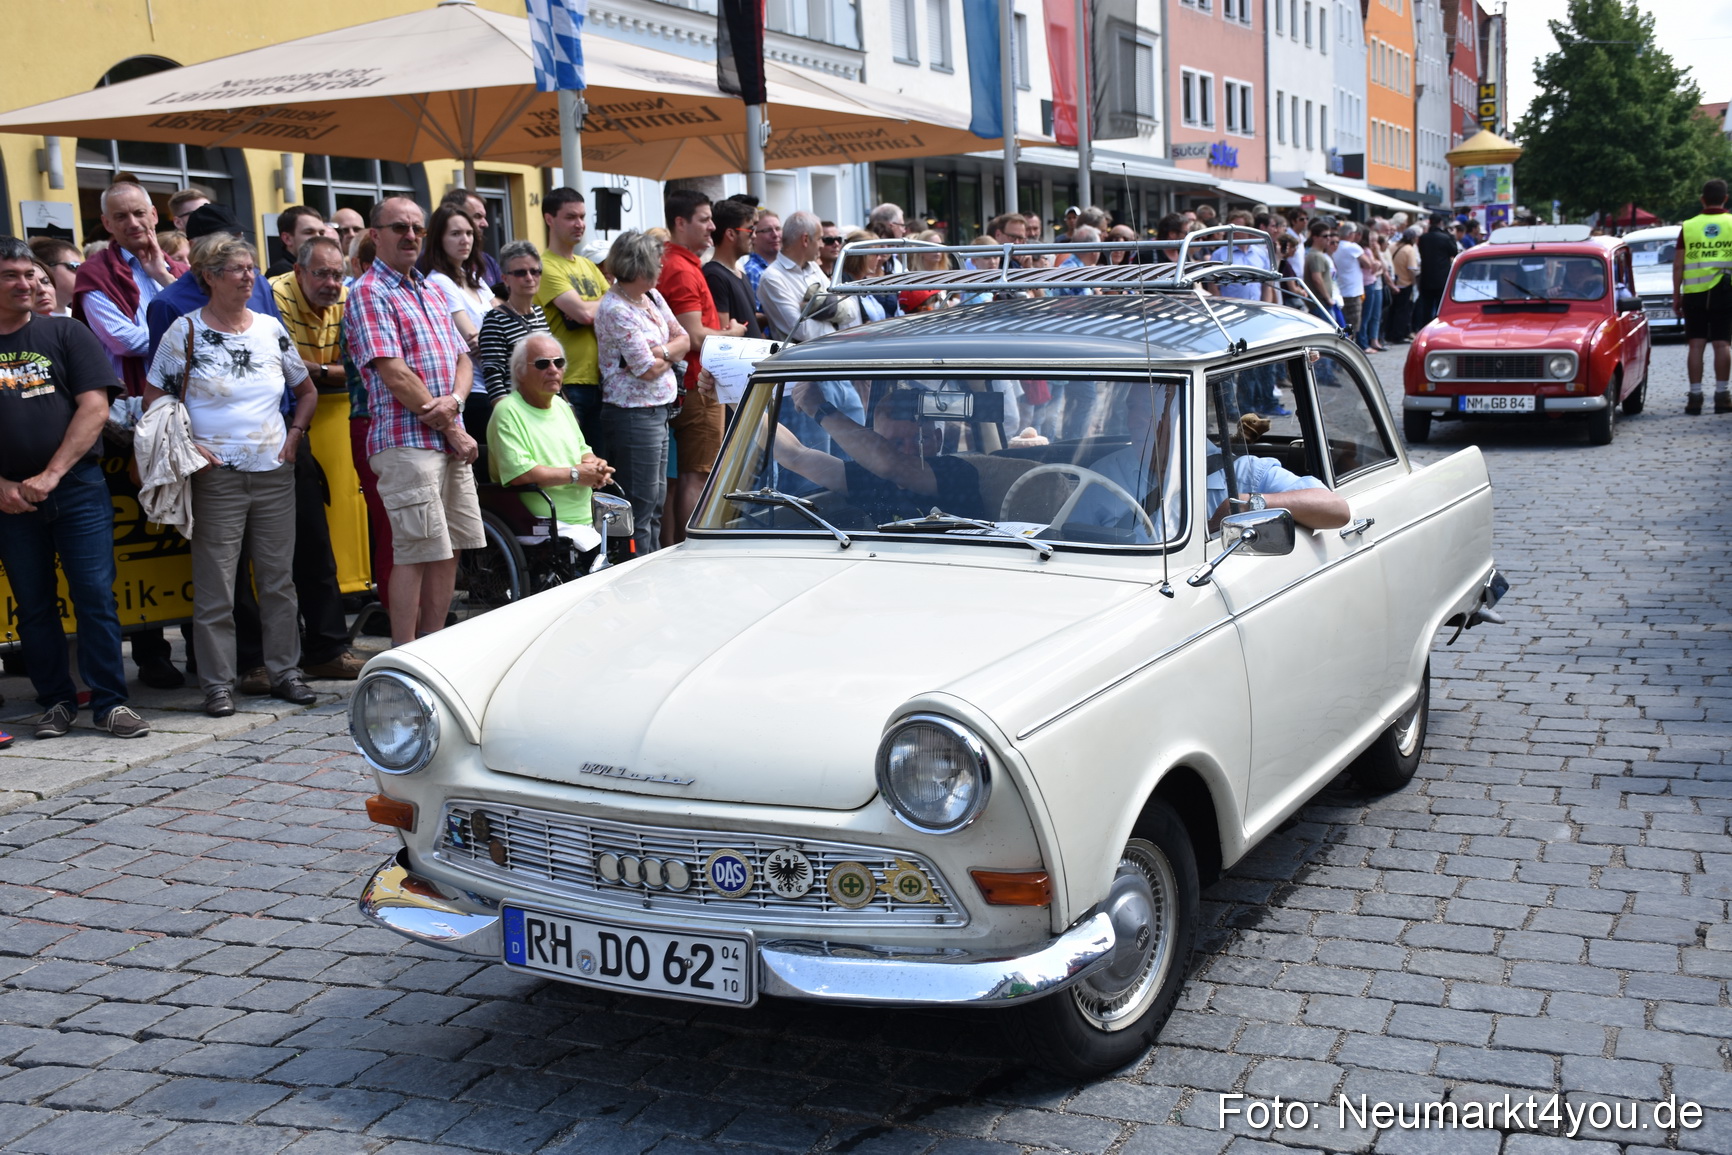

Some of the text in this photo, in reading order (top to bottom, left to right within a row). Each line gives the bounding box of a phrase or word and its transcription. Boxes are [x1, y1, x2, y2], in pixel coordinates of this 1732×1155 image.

[1689, 241, 1732, 251] FOLLOW
[1701, 250, 1718, 258] ME
[1467, 397, 1483, 409] NM
[1491, 397, 1507, 409] GB
[1509, 397, 1525, 409] 84
[715, 860, 745, 888] DAS
[512, 942, 520, 954] D
[526, 917, 714, 990] RH DO 62
[721, 945, 739, 961] 04
[722, 978, 739, 993] 10
